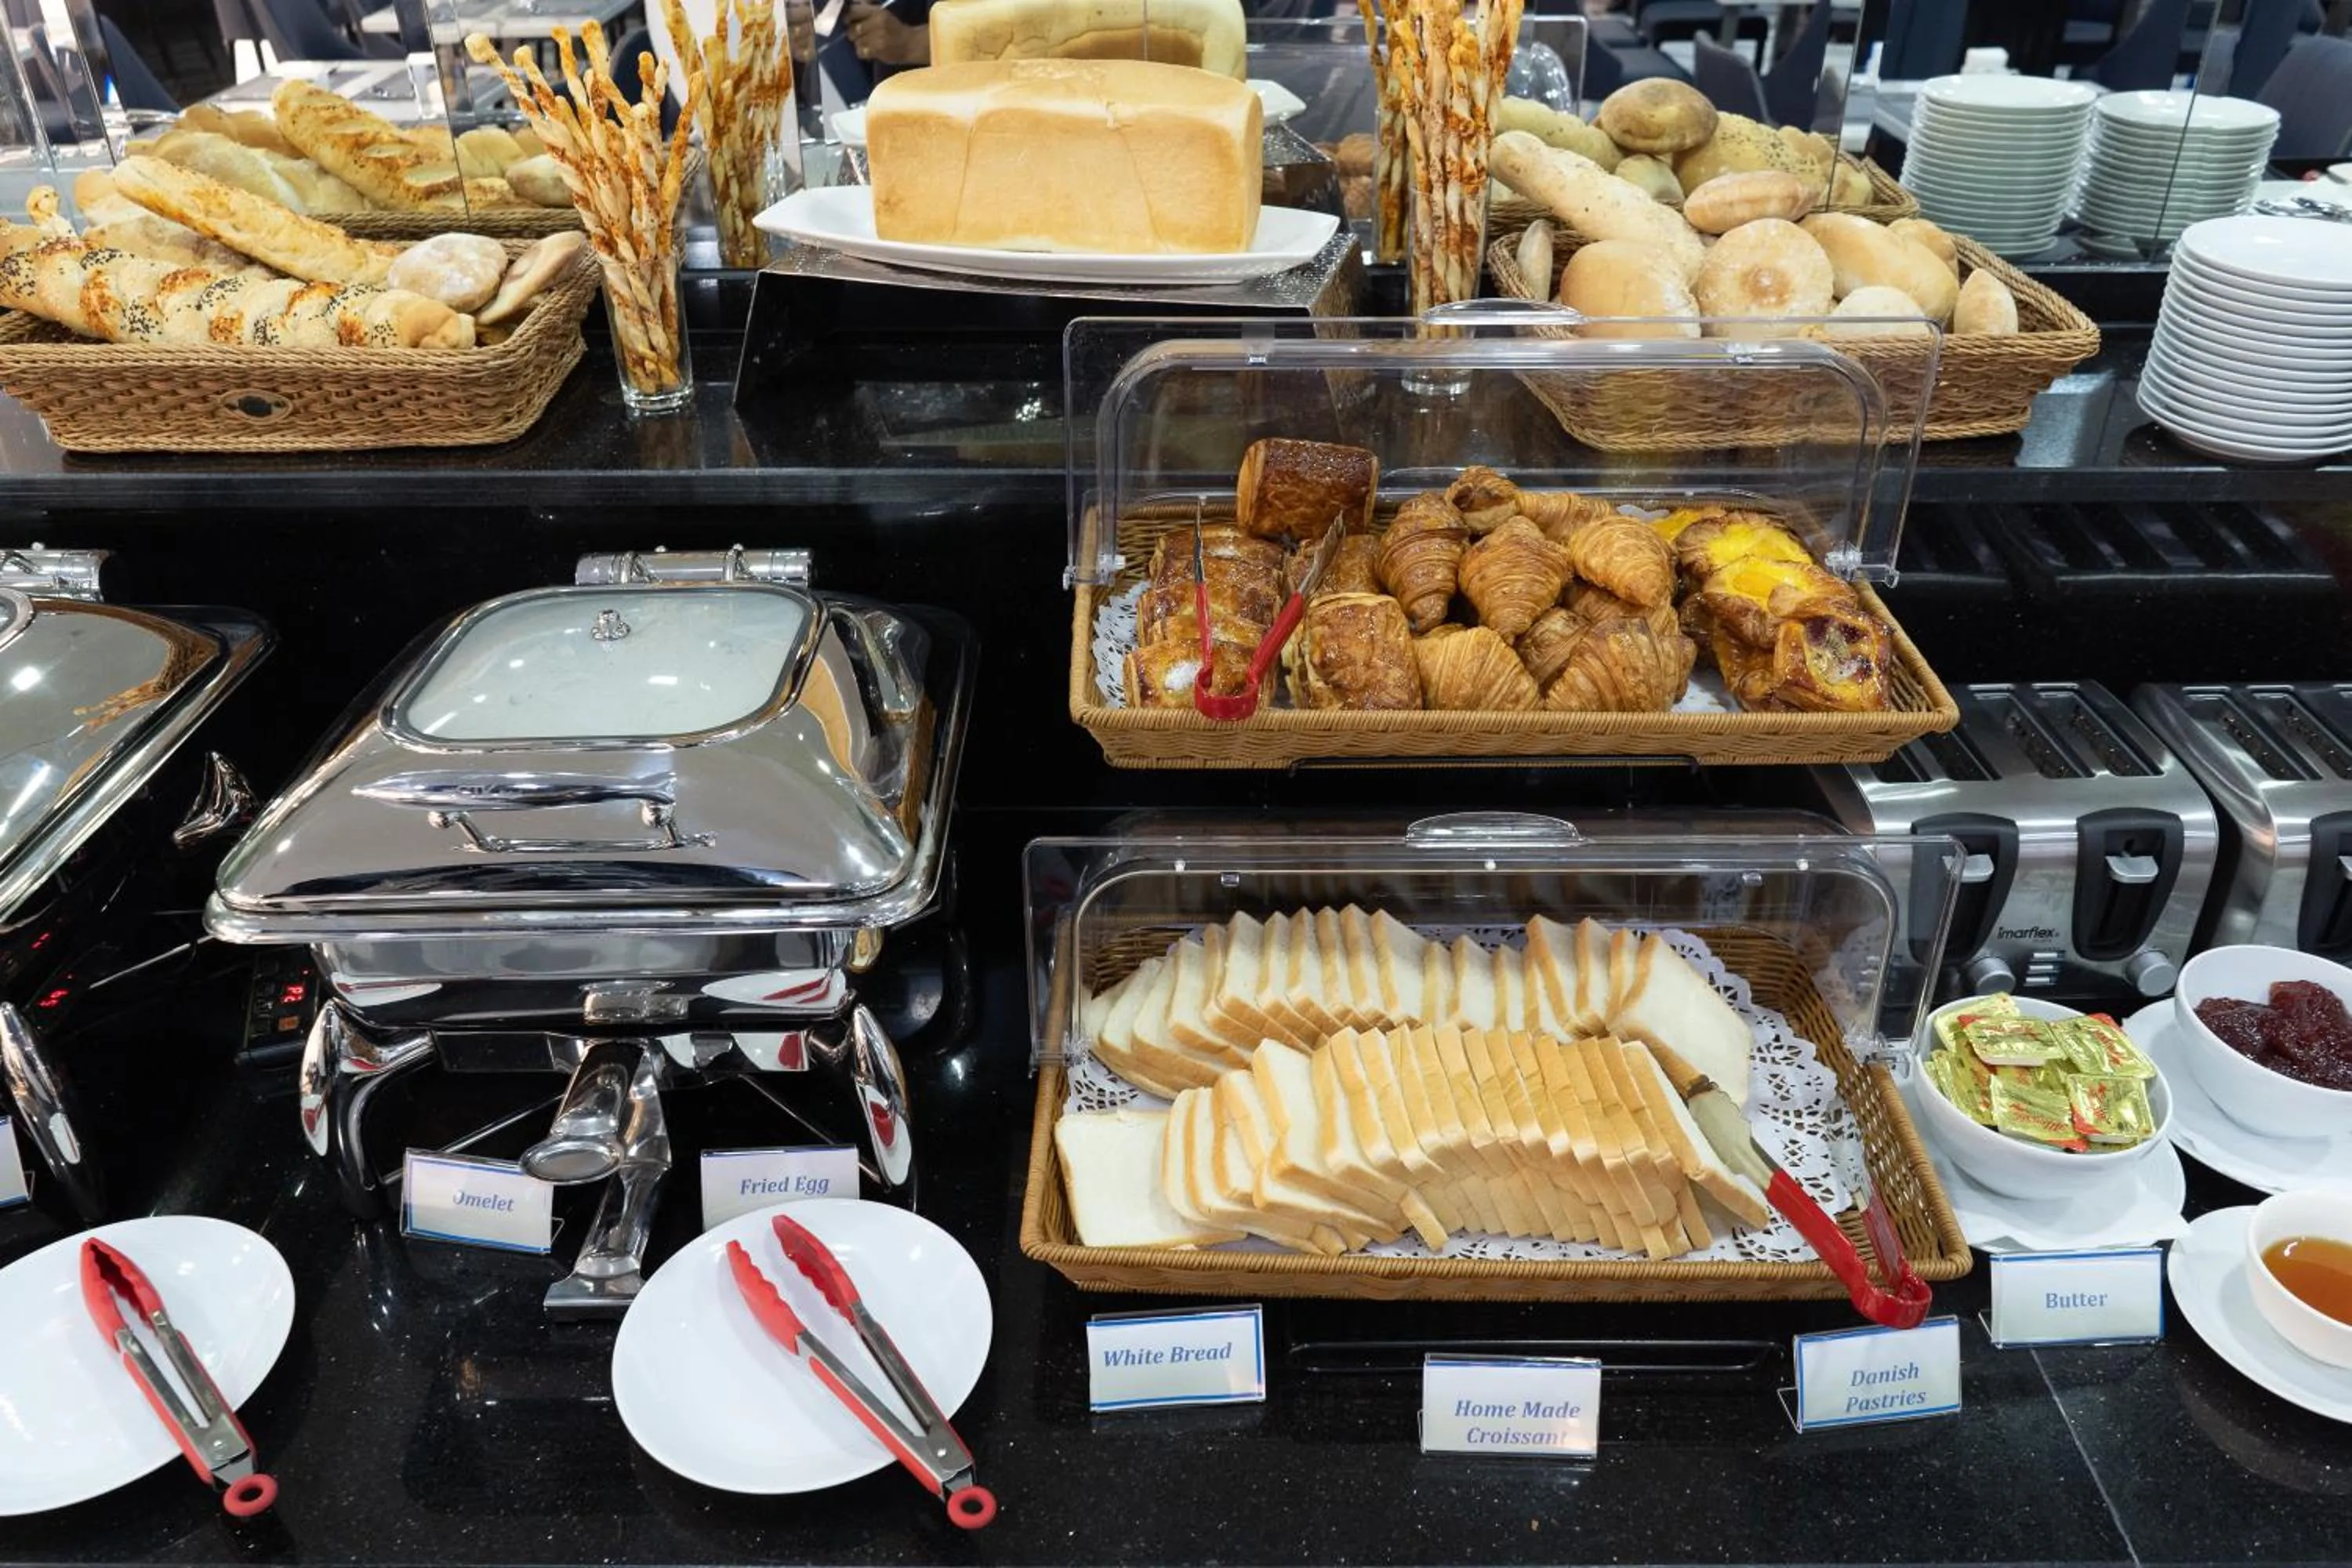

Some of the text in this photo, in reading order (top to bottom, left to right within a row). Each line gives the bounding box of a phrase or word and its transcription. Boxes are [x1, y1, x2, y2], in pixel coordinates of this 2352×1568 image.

[740, 1175, 829, 1195] Fried Egg
[2045, 1292, 2108, 1308] Butter
[1103, 1342, 1232, 1367] White Bread
[1850, 1362, 1920, 1387] Danish
[1454, 1399, 1581, 1418] Home Made
[1846, 1389, 1926, 1413] Pastries
